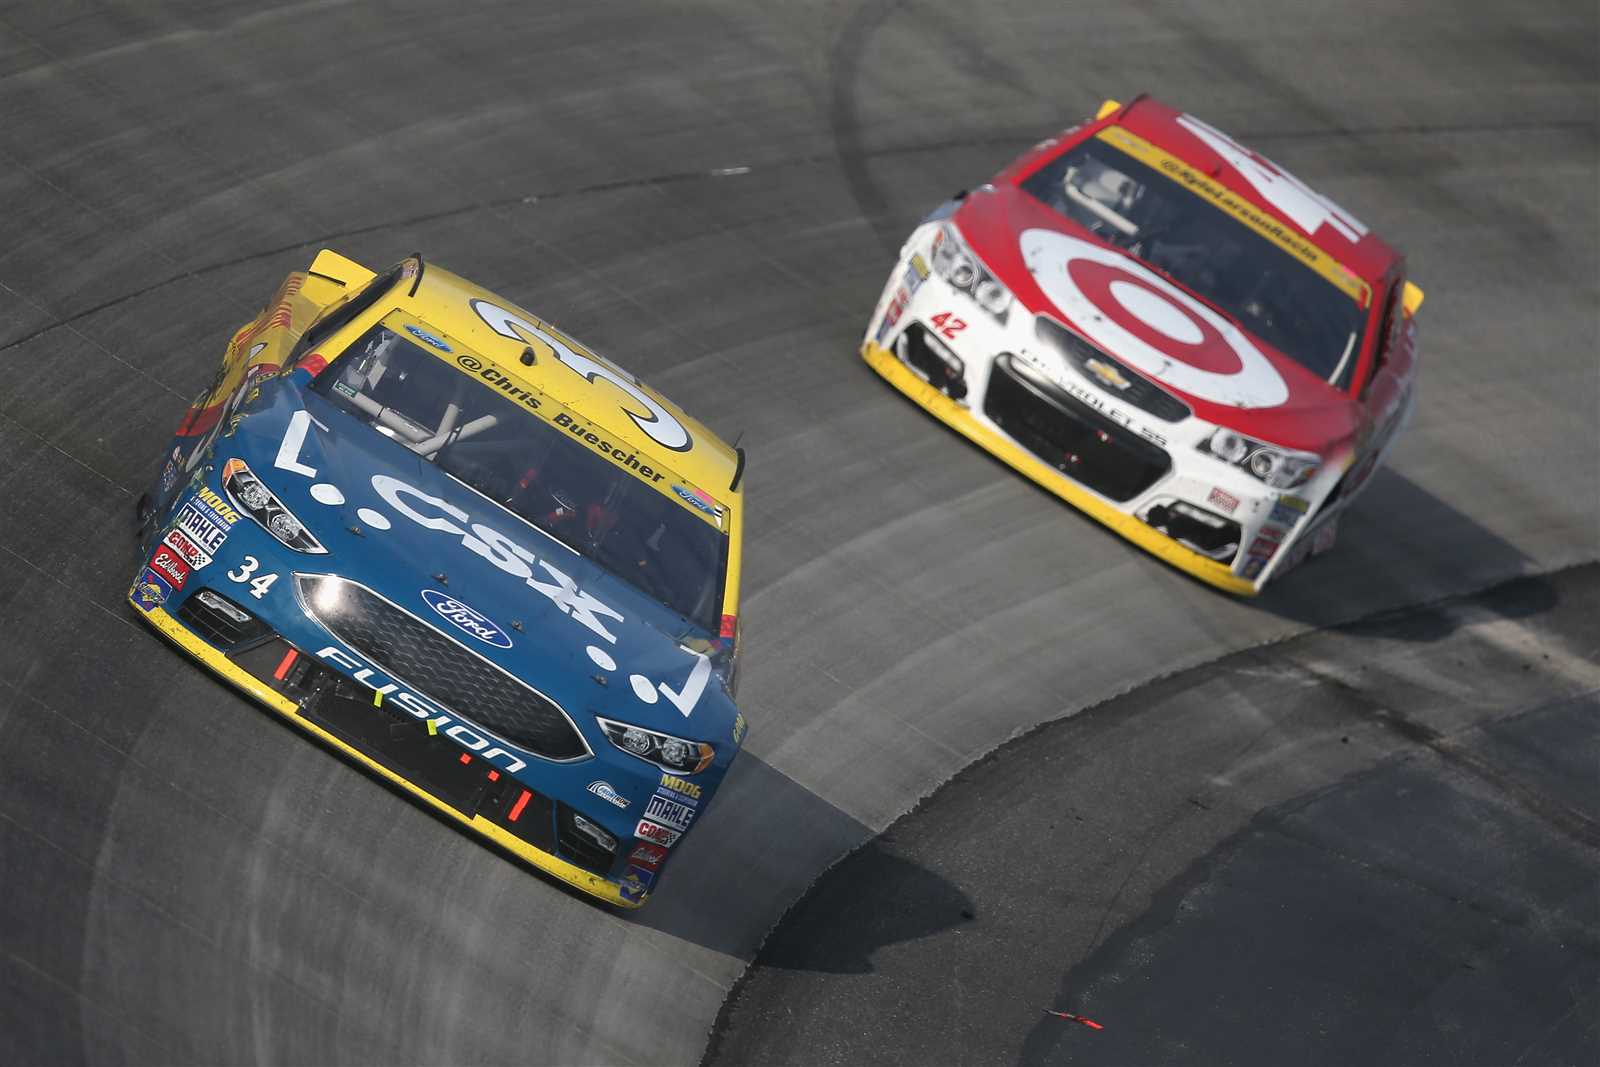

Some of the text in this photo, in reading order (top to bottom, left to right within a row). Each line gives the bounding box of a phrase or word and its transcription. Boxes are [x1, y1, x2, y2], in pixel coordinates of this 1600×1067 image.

[931, 312, 968, 340] 42
[469, 298, 693, 452] 3
[457, 355, 666, 483] @Chris Buescher
[199, 486, 242, 524] MOOG
[167, 530, 201, 561] COMP
[179, 506, 226, 552] MAHLE
[227, 555, 279, 599] 34
[371, 474, 625, 645] CSX
[436, 598, 497, 642] Ford
[316, 646, 528, 774] FUSION
[659, 774, 701, 798] MOOG
[647, 796, 694, 827] MAHLE
